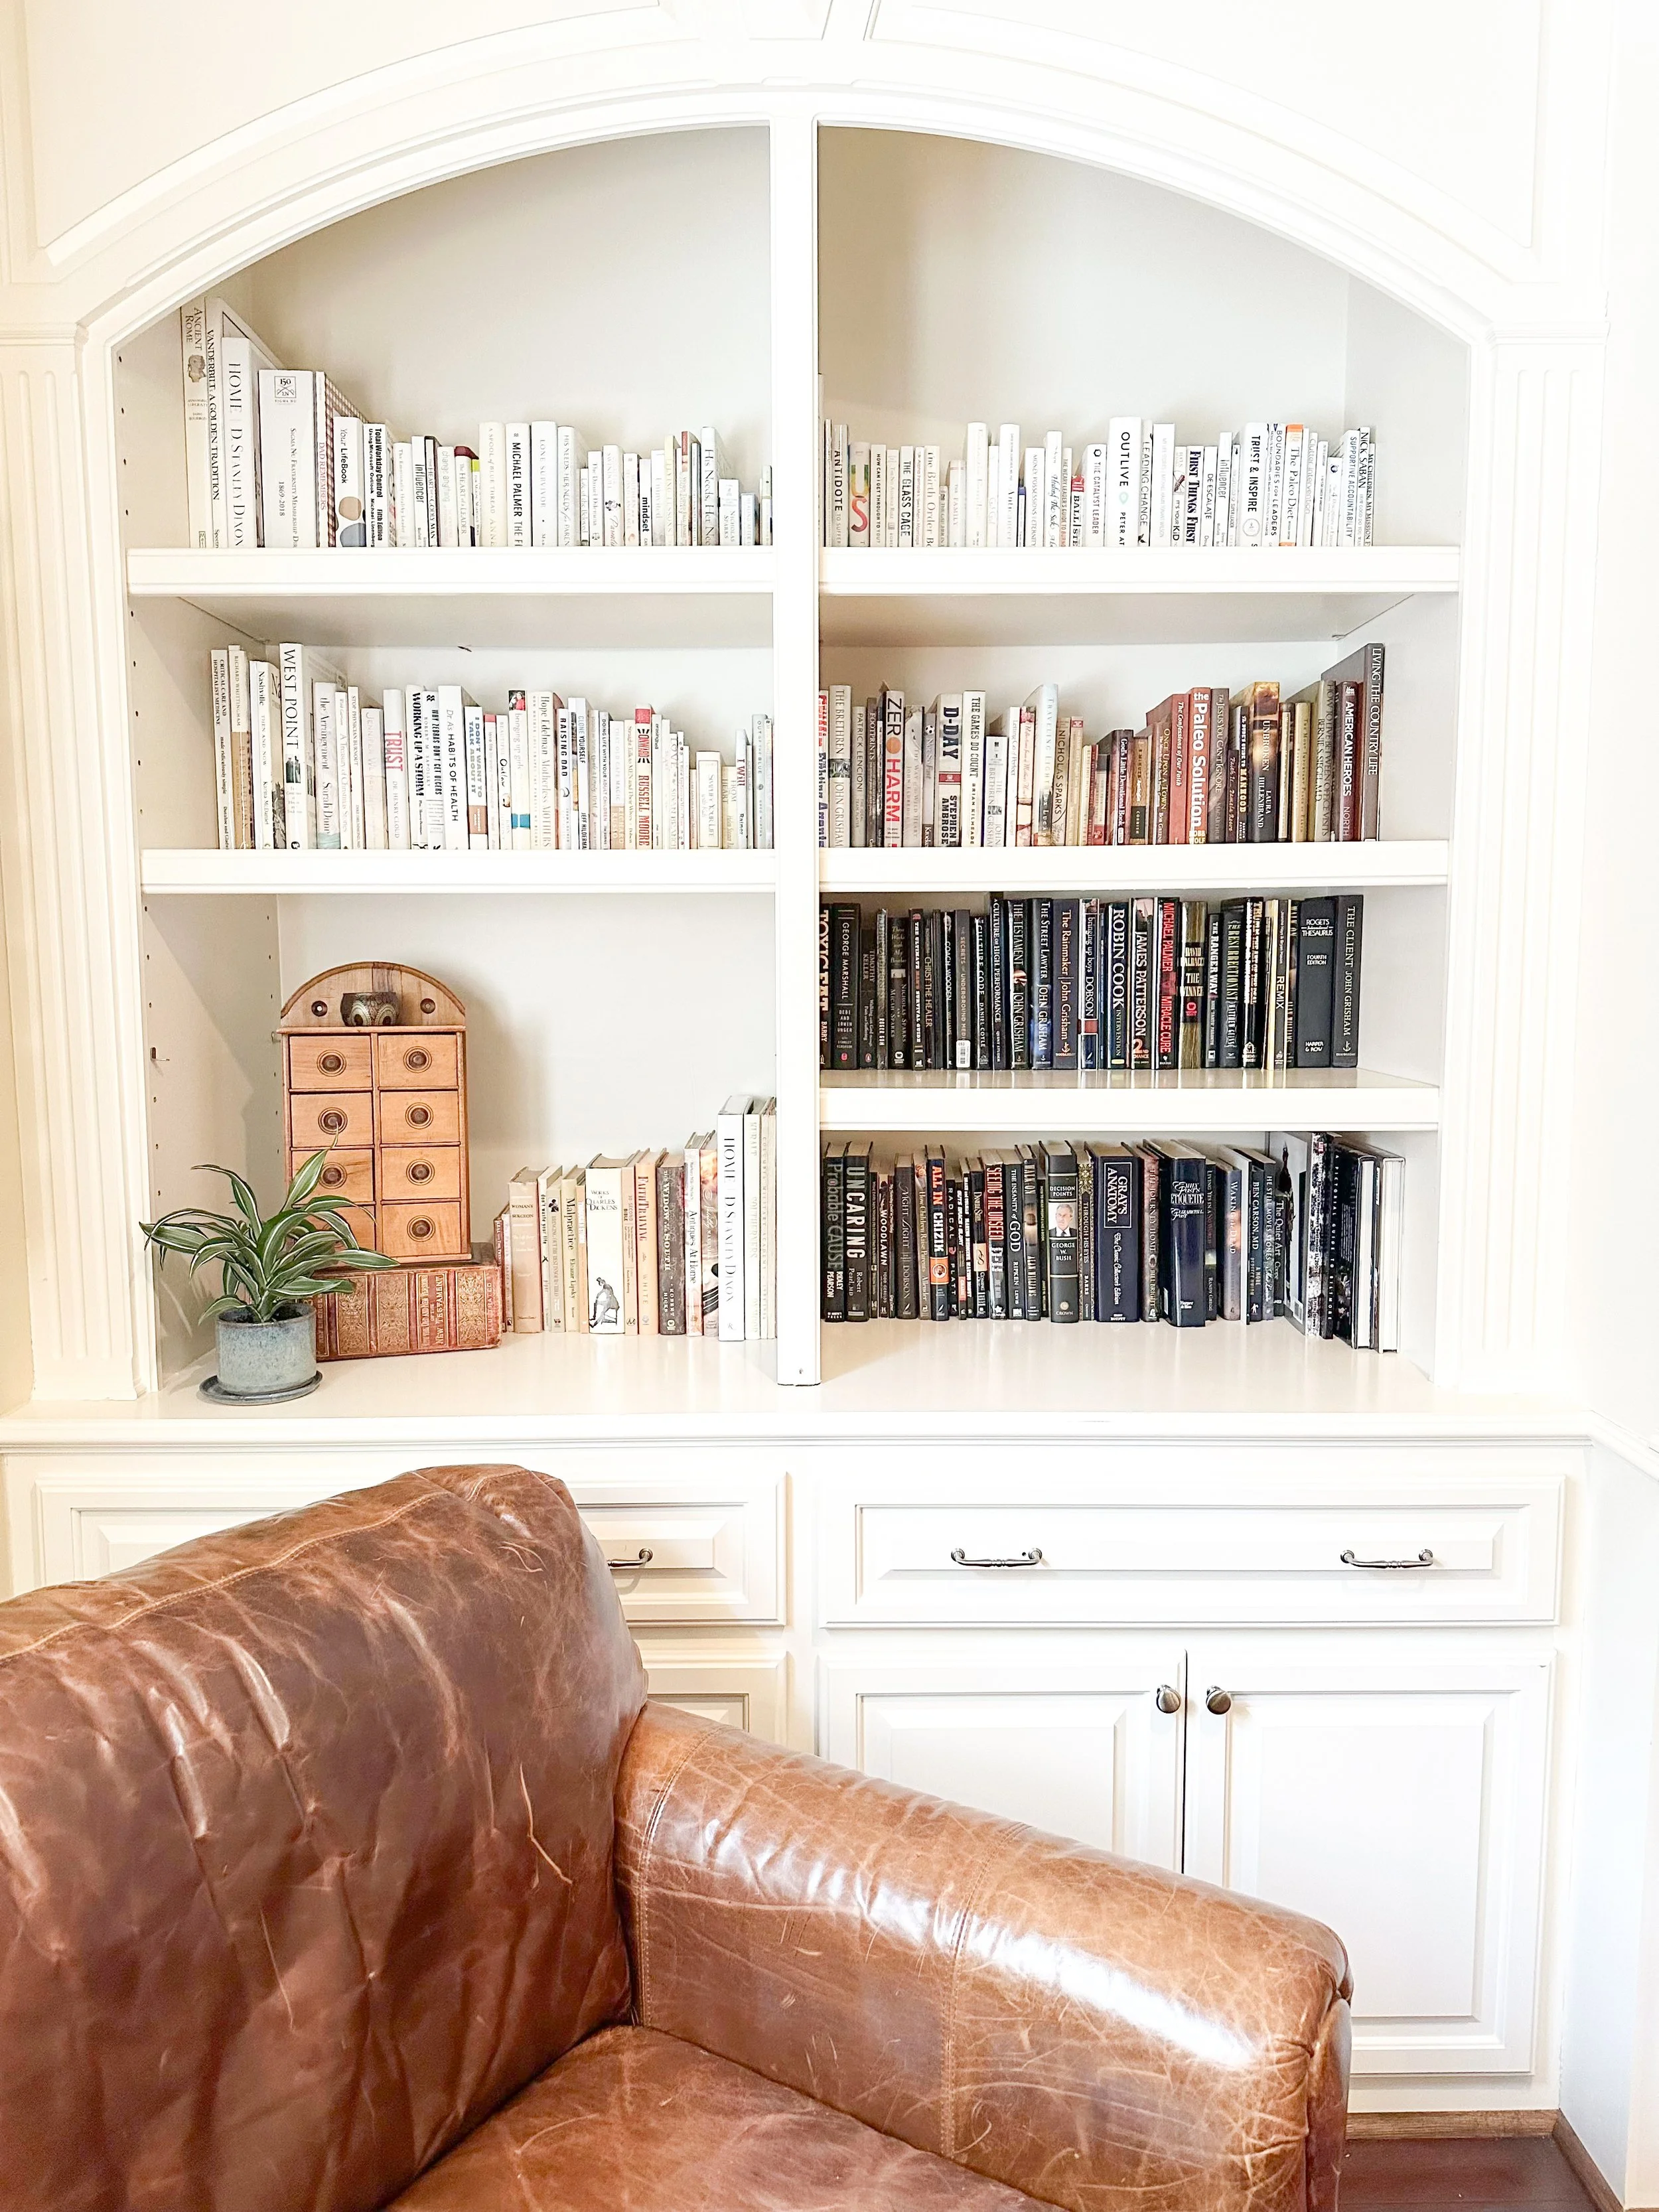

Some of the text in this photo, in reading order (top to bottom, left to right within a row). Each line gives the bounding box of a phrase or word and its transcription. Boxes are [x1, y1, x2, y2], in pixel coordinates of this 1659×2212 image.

[194, 307, 202, 350] ANCIENT
[206, 329, 216, 391] VANDERBILT:
[209, 403, 218, 444] GOLDEN
[1250, 435, 1261, 463] TRUST
[211, 447, 220, 500] TRADITION
[415, 464, 424, 503] Influencer
[512, 443, 522, 517] MICHAEL PALMER
[834, 451, 843, 511] ANTIDOTE
[1119, 431, 1130, 486] OUTLIVE
[1139, 442, 1150, 526] LEADING CHANGE
[1287, 447, 1300, 520] The Paleo Diet
[1358, 432, 1369, 488] NICK SABAN
[901, 461, 911, 536] THE GLASS CAGE
[1186, 451, 1201, 544] FIRST THINGS FIRST
[1248, 477, 1258, 512] INSPIRE
[1346, 437, 1357, 538] SUPPORTIVE ACCOUNTABILITY
[283, 649, 299, 749] WEST POINT
[412, 692, 423, 738] WORKING
[1368, 648, 1382, 775] LIVING THE COUNTRY LIFE
[384, 731, 403, 771] TRUST
[414, 741, 423, 753] UP
[637, 734, 650, 758] ONWARD
[942, 707, 960, 760] D-DAY
[1262, 719, 1271, 771] UNBROKEN
[415, 763, 425, 796] STORM
[447, 734, 459, 821] HABITS OF HEALTH
[737, 766, 745, 786] Will
[886, 759, 901, 822] HARM
[1054, 729, 1065, 814] NICHOLAS SPARKS
[1118, 774, 1127, 809] Devotional
[1190, 703, 1208, 828] Paleo Solution
[1342, 701, 1354, 836] AMERICAN HEROES NORTH
[638, 775, 650, 846] RUSSELL MOORE
[949, 795, 958, 839] STEPHEN
[1039, 902, 1050, 979] THE STREET LAWYER
[1346, 906, 1356, 928] THE
[1060, 909, 1072, 1040] The Rainmaker John Grisham
[1084, 917, 1095, 1017] bringing up boys DOBSON
[1112, 909, 1125, 1009] ROBIN COOK
[1209, 936, 1219, 994] RANGER WAY
[1345, 930, 1354, 967] CLIENT
[1013, 904, 1025, 1052] THE TESTAMENT JOHN GRISHAM
[1135, 931, 1147, 1036] JAMES PATTERSON
[1160, 903, 1175, 1053] MICHAEL PALMER MIRACLE CURE
[1276, 976, 1285, 1009] REMIX
[1343, 995, 1352, 1036] GRISHAM
[986, 1167, 1003, 1193] SEEING
[987, 1195, 1003, 1209] THE
[1106, 1167, 1118, 1223] ANATOMY
[1118, 1176, 1128, 1215] GRAY'S
[563, 1198, 576, 1250] Malpractice
[826, 1164, 842, 1269] Probable CAUSE
[846, 1166, 865, 1258] UNCARING
[932, 1166, 944, 1253] ALL IN CHIZIK
[988, 1211, 1004, 1240] UNSEEN
[1274, 1201, 1284, 1256] The Quiet Art
[687, 1211, 698, 1284] Antiques At Home
